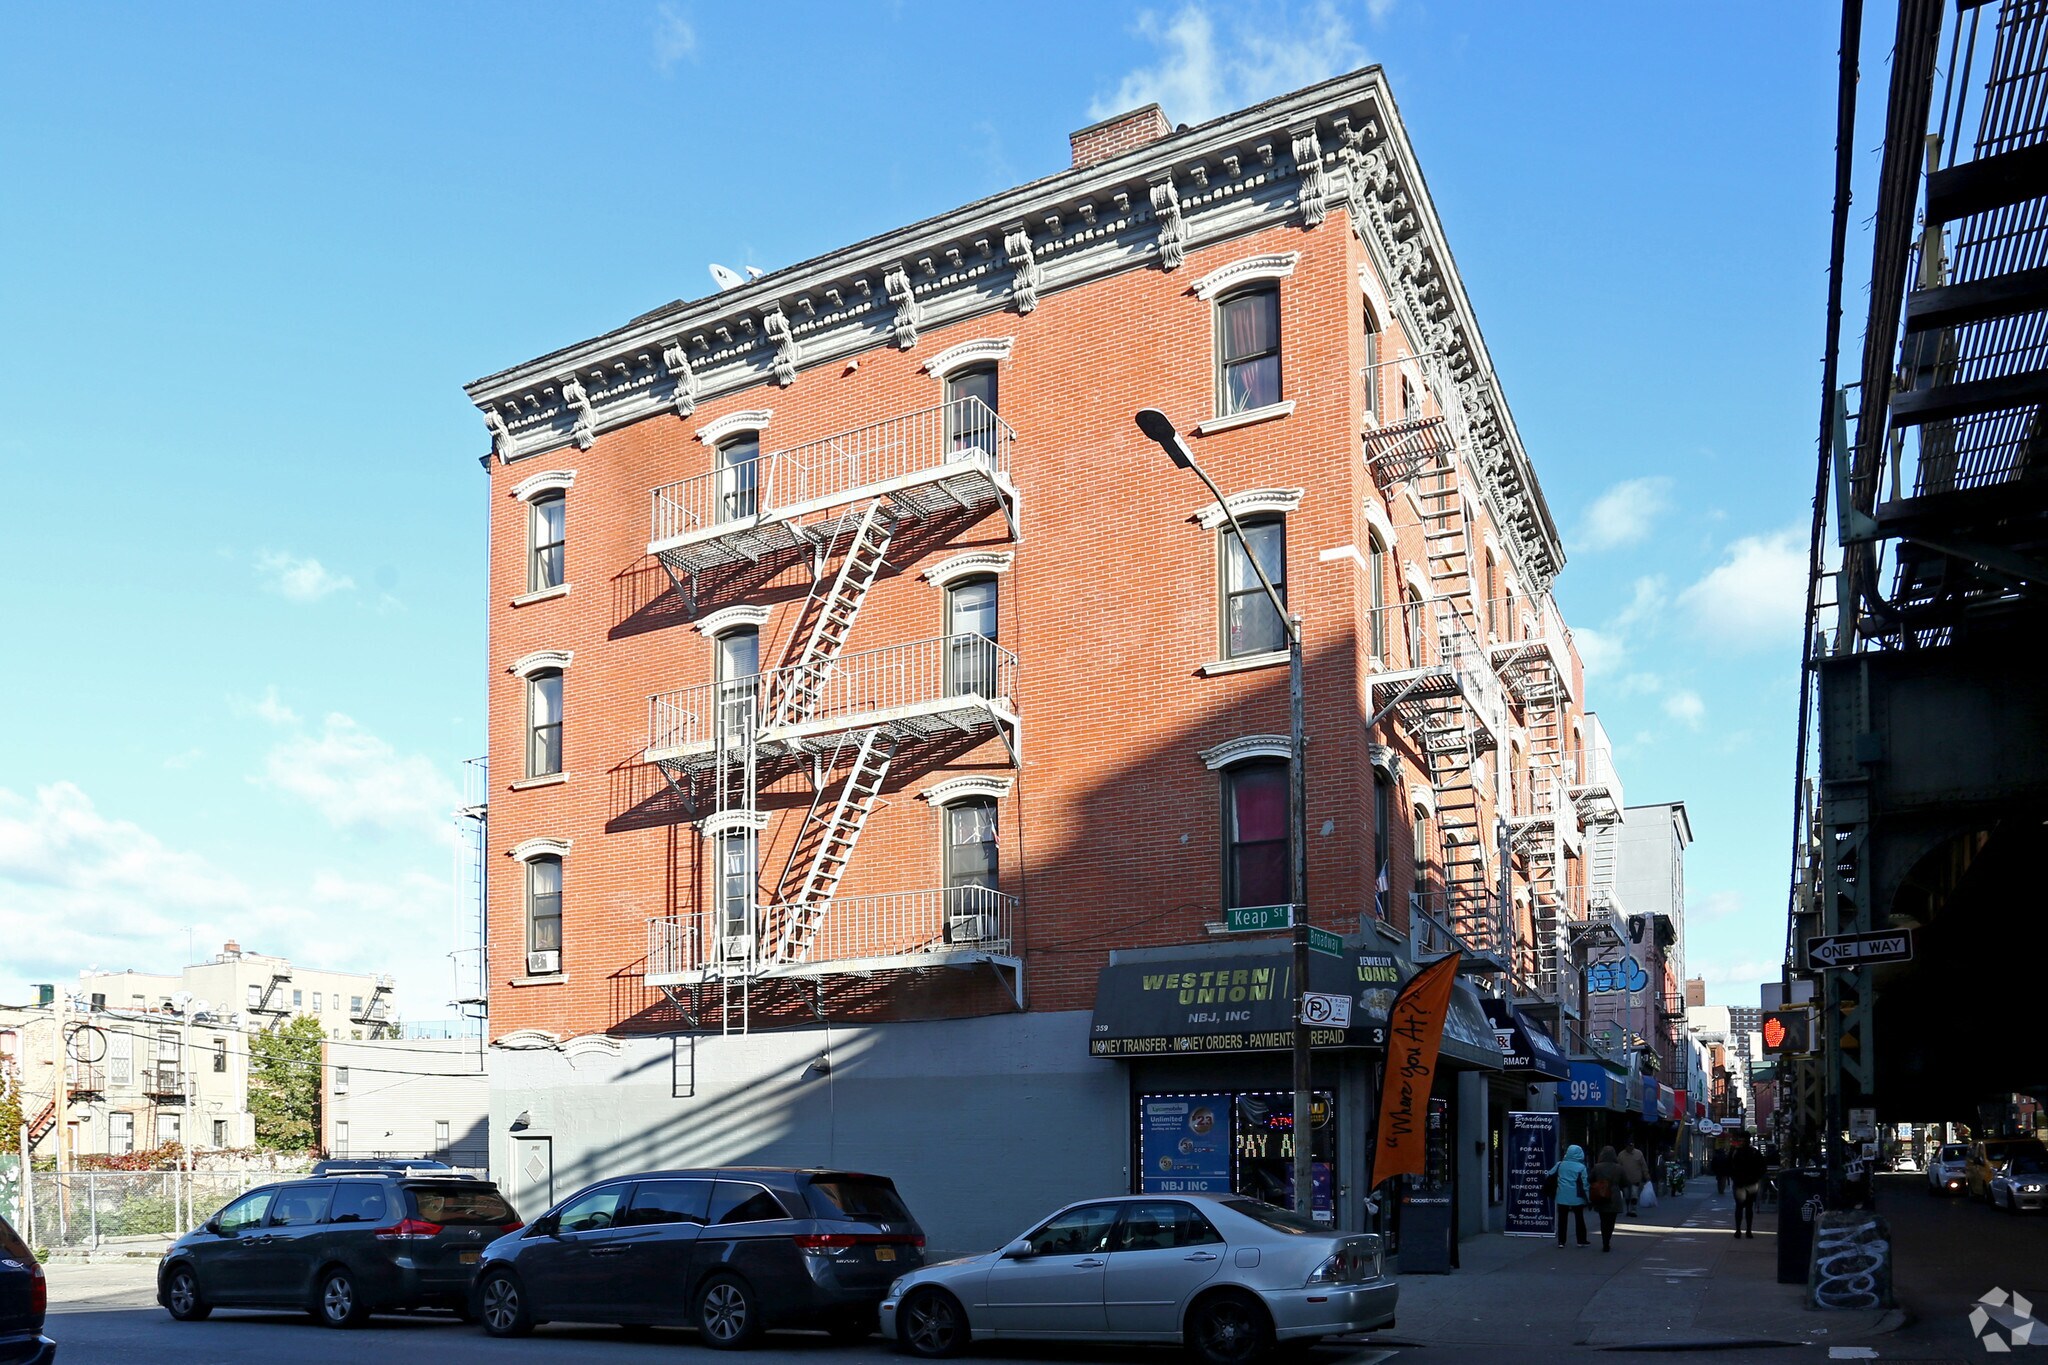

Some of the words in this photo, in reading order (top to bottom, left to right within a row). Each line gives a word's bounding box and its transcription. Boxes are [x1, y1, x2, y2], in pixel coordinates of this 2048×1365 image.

[1235, 911, 1268, 928] Keap
[1273, 908, 1284, 917] St
[1310, 929, 1339, 956] Broadway
[1822, 944, 1852, 959] ONE
[1868, 939, 1901, 954] WAY
[1359, 956, 1392, 967] JEWELRY
[1142, 967, 1270, 991] WESTERN
[1357, 966, 1399, 983] LOANS
[1179, 985, 1268, 1005] UNION
[1188, 1012, 1220, 1024] NBJ,
[1225, 1010, 1251, 1021] INC
[1092, 1040, 1121, 1054] MONEY
[1122, 1038, 1167, 1053] TRANSFER
[1173, 1036, 1204, 1051] MONEY
[1206, 1034, 1243, 1050] ORDERS
[1503, 1057, 1530, 1066] RMACY
[1571, 1080, 1588, 1101] 99
[1591, 1090, 1602, 1101] up
[1514, 1121, 1553, 1131] Pharmacy
[1161, 1181, 1184, 1191] NBJ
[1187, 1181, 1208, 1191] INC
